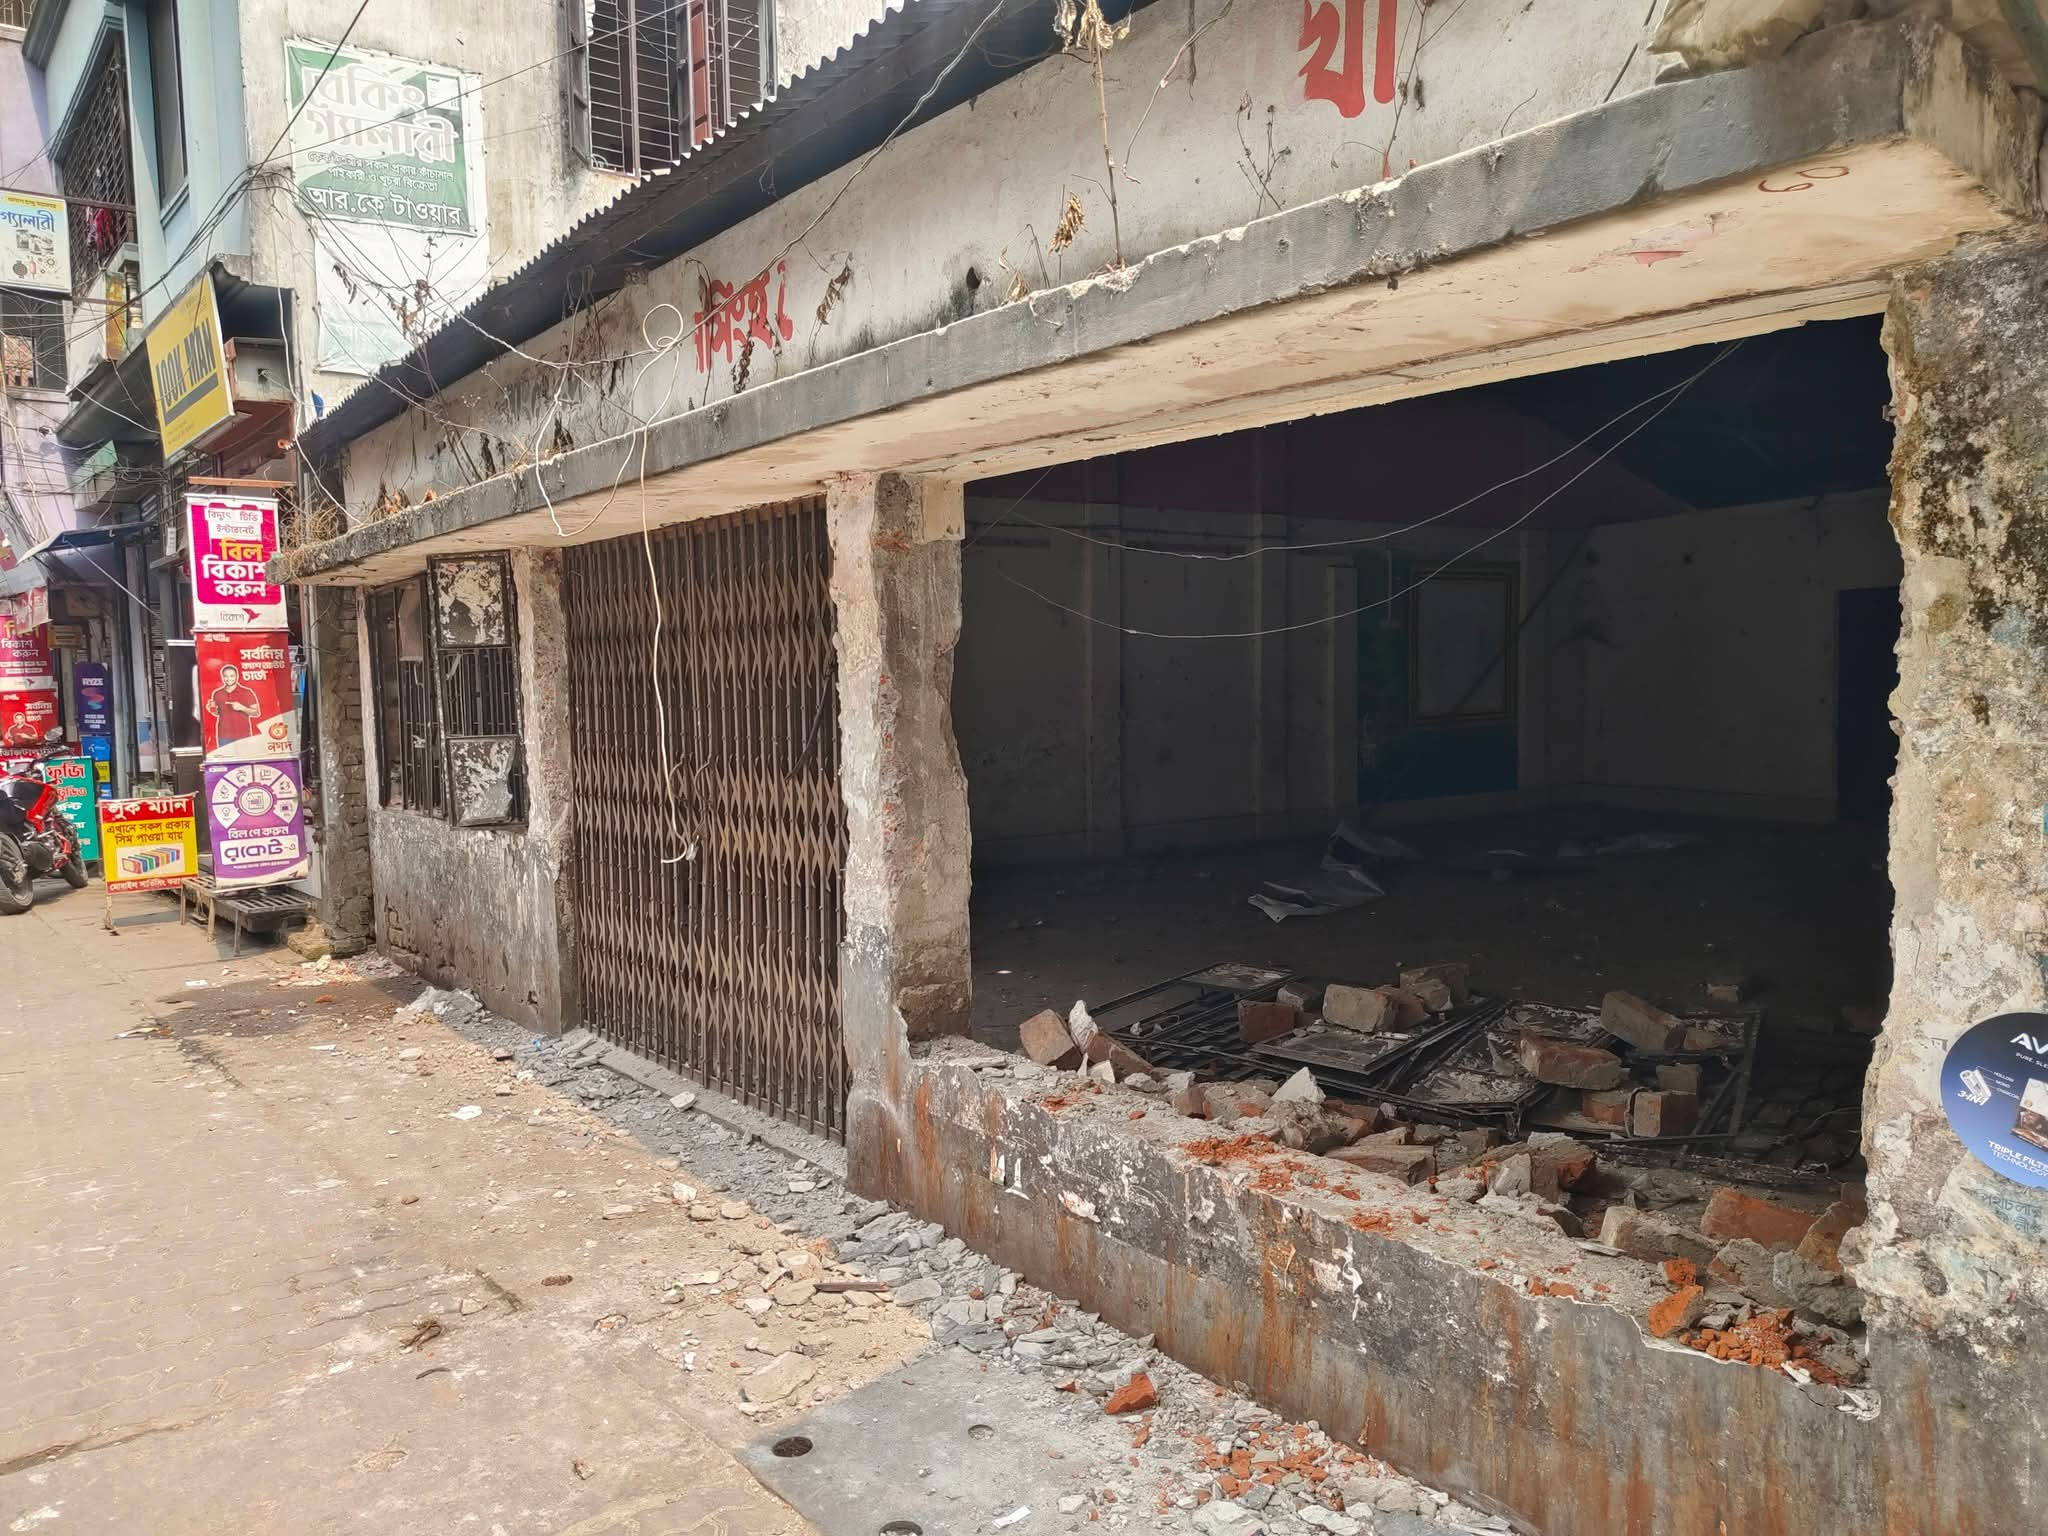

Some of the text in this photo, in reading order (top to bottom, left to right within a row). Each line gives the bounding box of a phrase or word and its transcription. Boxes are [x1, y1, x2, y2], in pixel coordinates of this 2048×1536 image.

[390, 192, 461, 225] টাওয়ার
[184, 317, 216, 387] MAN
[220, 537, 263, 561] বিল
[213, 580, 267, 597] করুন
[267, 741, 293, 753] নগদ
[46, 760, 86, 786] ফুজি
[108, 798, 187, 821] লুক ম্যান
[107, 820, 191, 834] এখানে সকল প্রকার
[227, 828, 248, 839] বিল
[114, 833, 132, 844] সিম
[1988, 1140, 2022, 1160] TRIPLE
